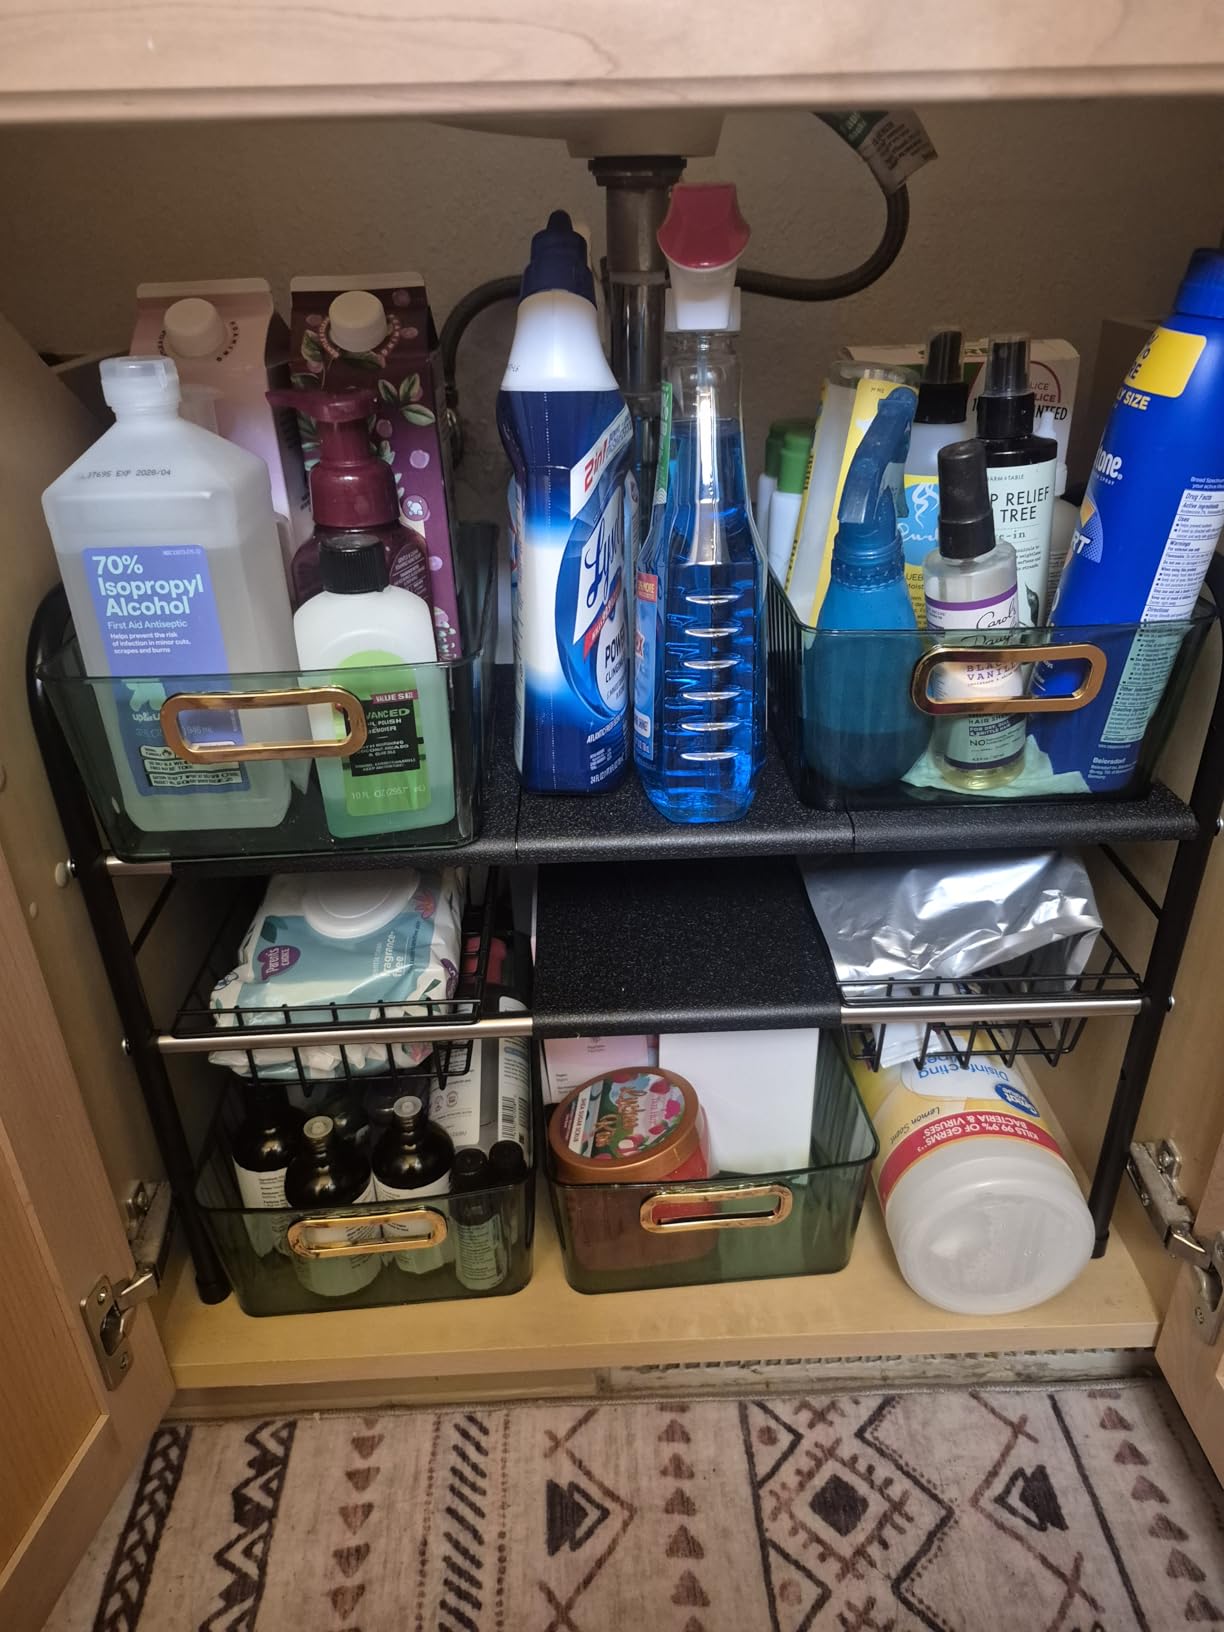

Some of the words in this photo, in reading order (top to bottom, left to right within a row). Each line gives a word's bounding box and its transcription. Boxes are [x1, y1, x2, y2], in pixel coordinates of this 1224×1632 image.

[1123, 393, 1151, 410] SIZE
[1006, 486, 1050, 507] RELIEF
[1000, 505, 1037, 523] TREE
[92, 554, 143, 575] 70%
[98, 574, 204, 599] Isopropyl
[106, 596, 190, 616] Alcohol
[107, 621, 127, 630] First
[128, 620, 143, 629] Aid
[144, 619, 188, 630] Antiseptic
[110, 632, 128, 640] Helps
[128, 632, 154, 640] prevent
[120, 639, 148, 647] infection
[114, 647, 139, 655] scrapes
[969, 739, 986, 747] NO
[265, 947, 281, 976] Parent's
[918, 1063, 1009, 1082] Disinfcting
[575, 1111, 585, 1127] SUGAR
[911, 1106, 941, 1125] Lemon
[977, 1115, 1027, 1131] BACTERIA
[889, 1122, 910, 1144] Scent
[966, 1123, 981, 1132] OF
[986, 1123, 1014, 1136] 99.9%
[1016, 1128, 1039, 1141] KILLS
